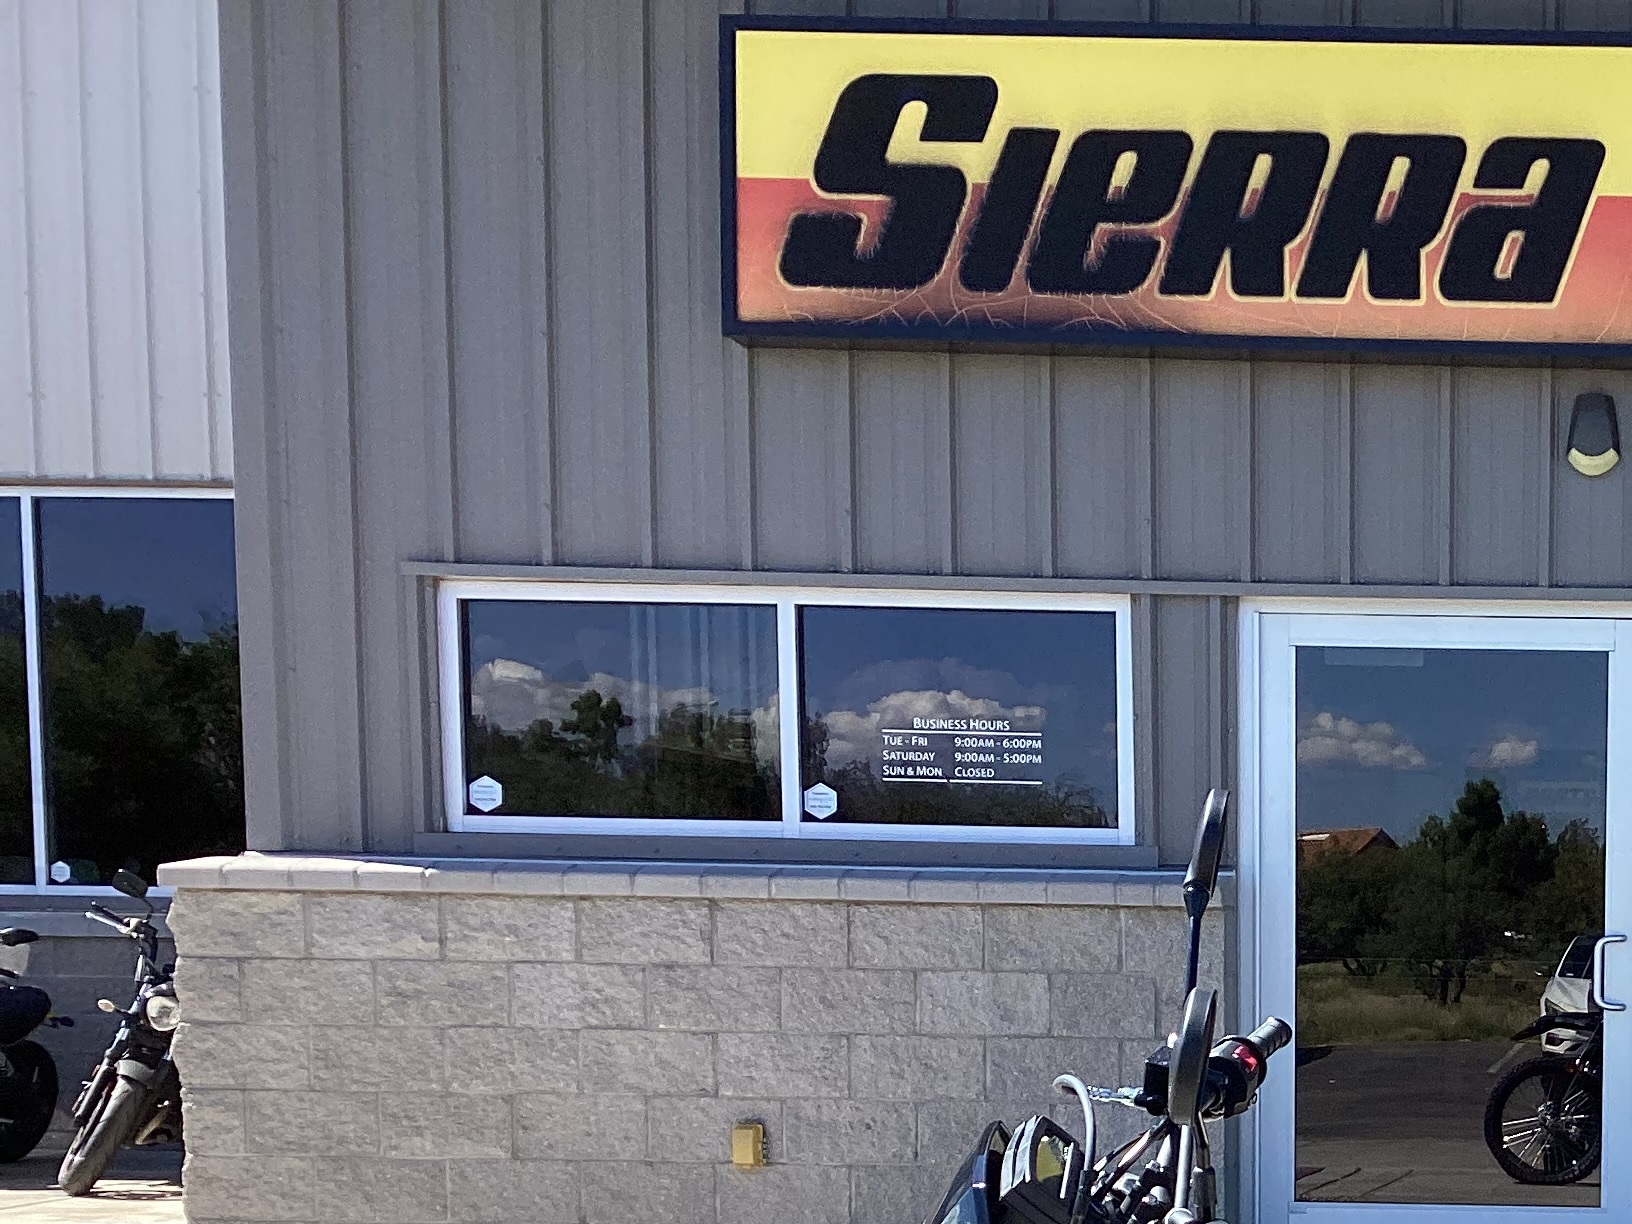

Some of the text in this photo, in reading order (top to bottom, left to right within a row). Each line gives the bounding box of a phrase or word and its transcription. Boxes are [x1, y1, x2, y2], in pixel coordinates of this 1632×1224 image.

[913, 717, 1011, 731] BUSINESS HOURS
[882, 735, 903, 746] TUE
[911, 736, 928, 747] FRI
[954, 737, 995, 748] 9:00AM
[1002, 738, 1042, 749] 6:00PM
[882, 750, 936, 761] SATURDAY
[954, 752, 995, 763] 9:00AM
[1002, 753, 1042, 764] 5:00PM
[882, 765, 995, 778] SUN & MON CLOSED
